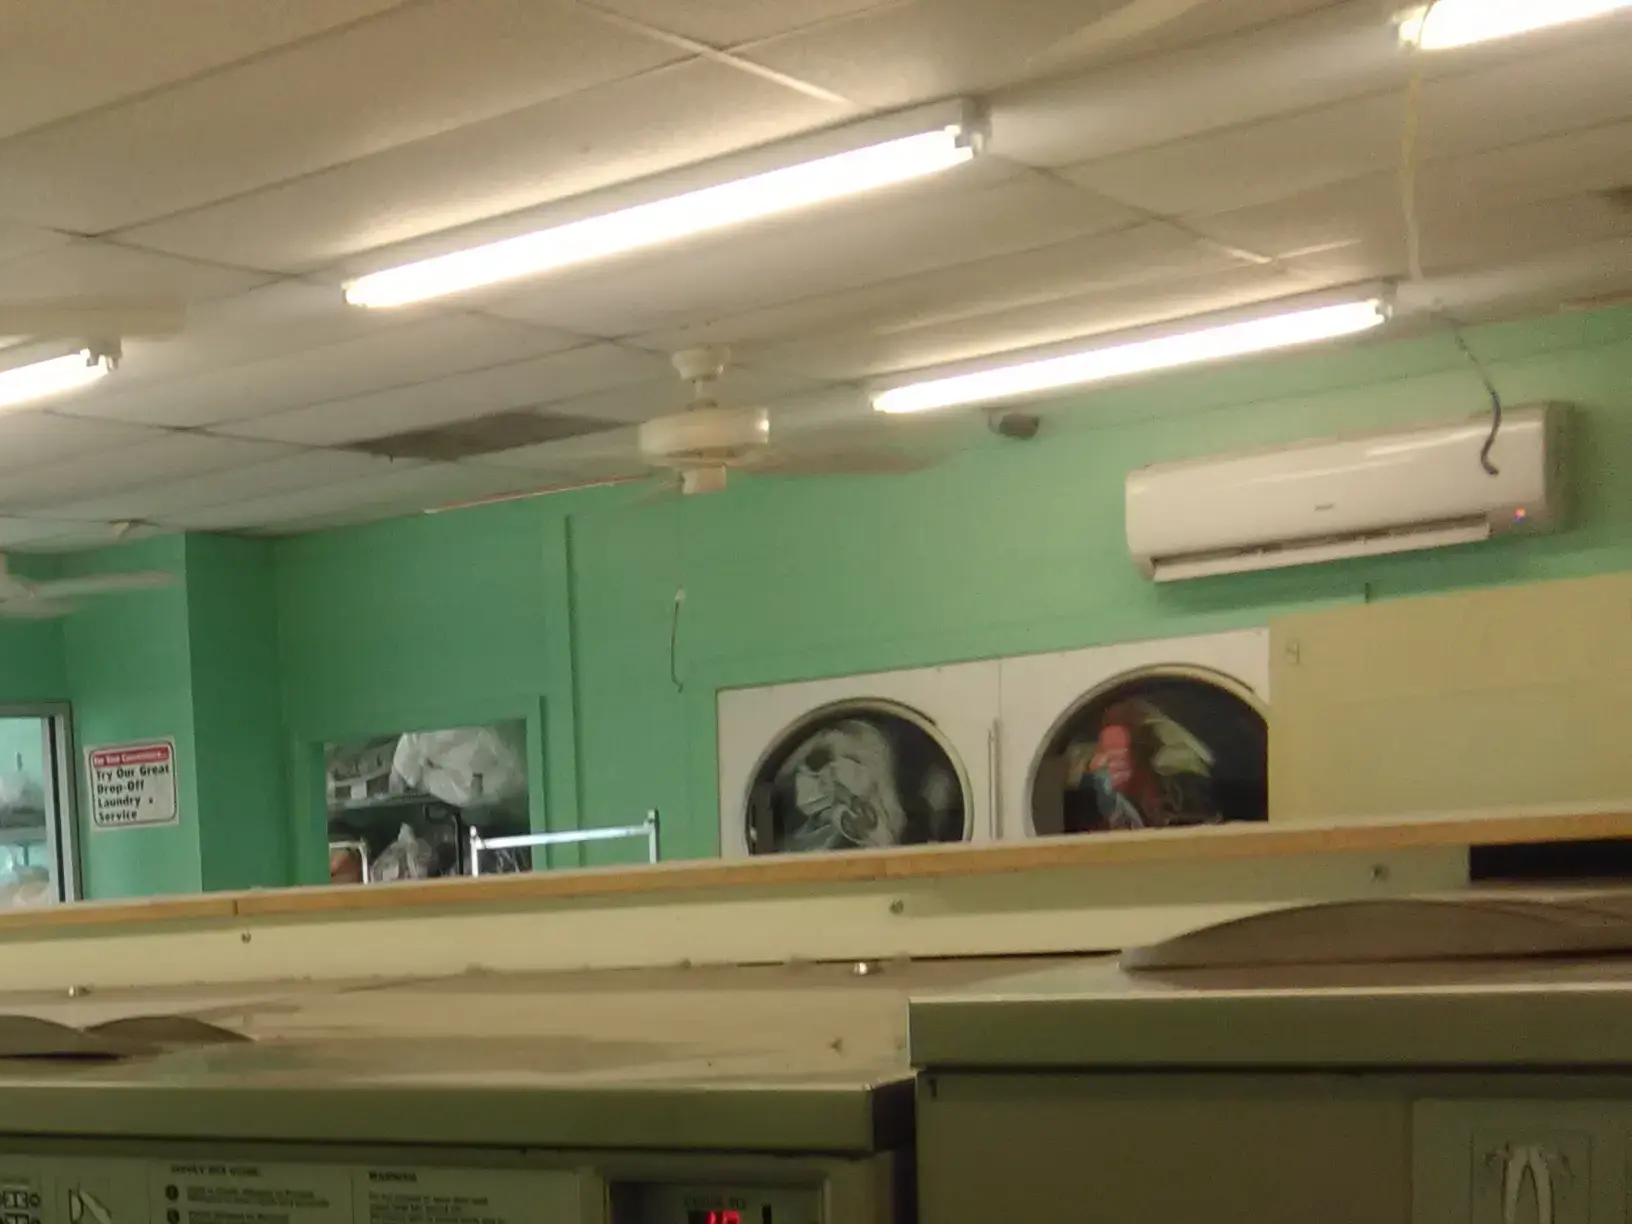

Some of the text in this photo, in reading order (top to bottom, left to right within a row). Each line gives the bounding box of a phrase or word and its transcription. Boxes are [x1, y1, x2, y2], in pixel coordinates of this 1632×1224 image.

[96, 764, 170, 782] Try Our Great
[97, 795, 141, 809] Laundry
[98, 810, 138, 823] Service
